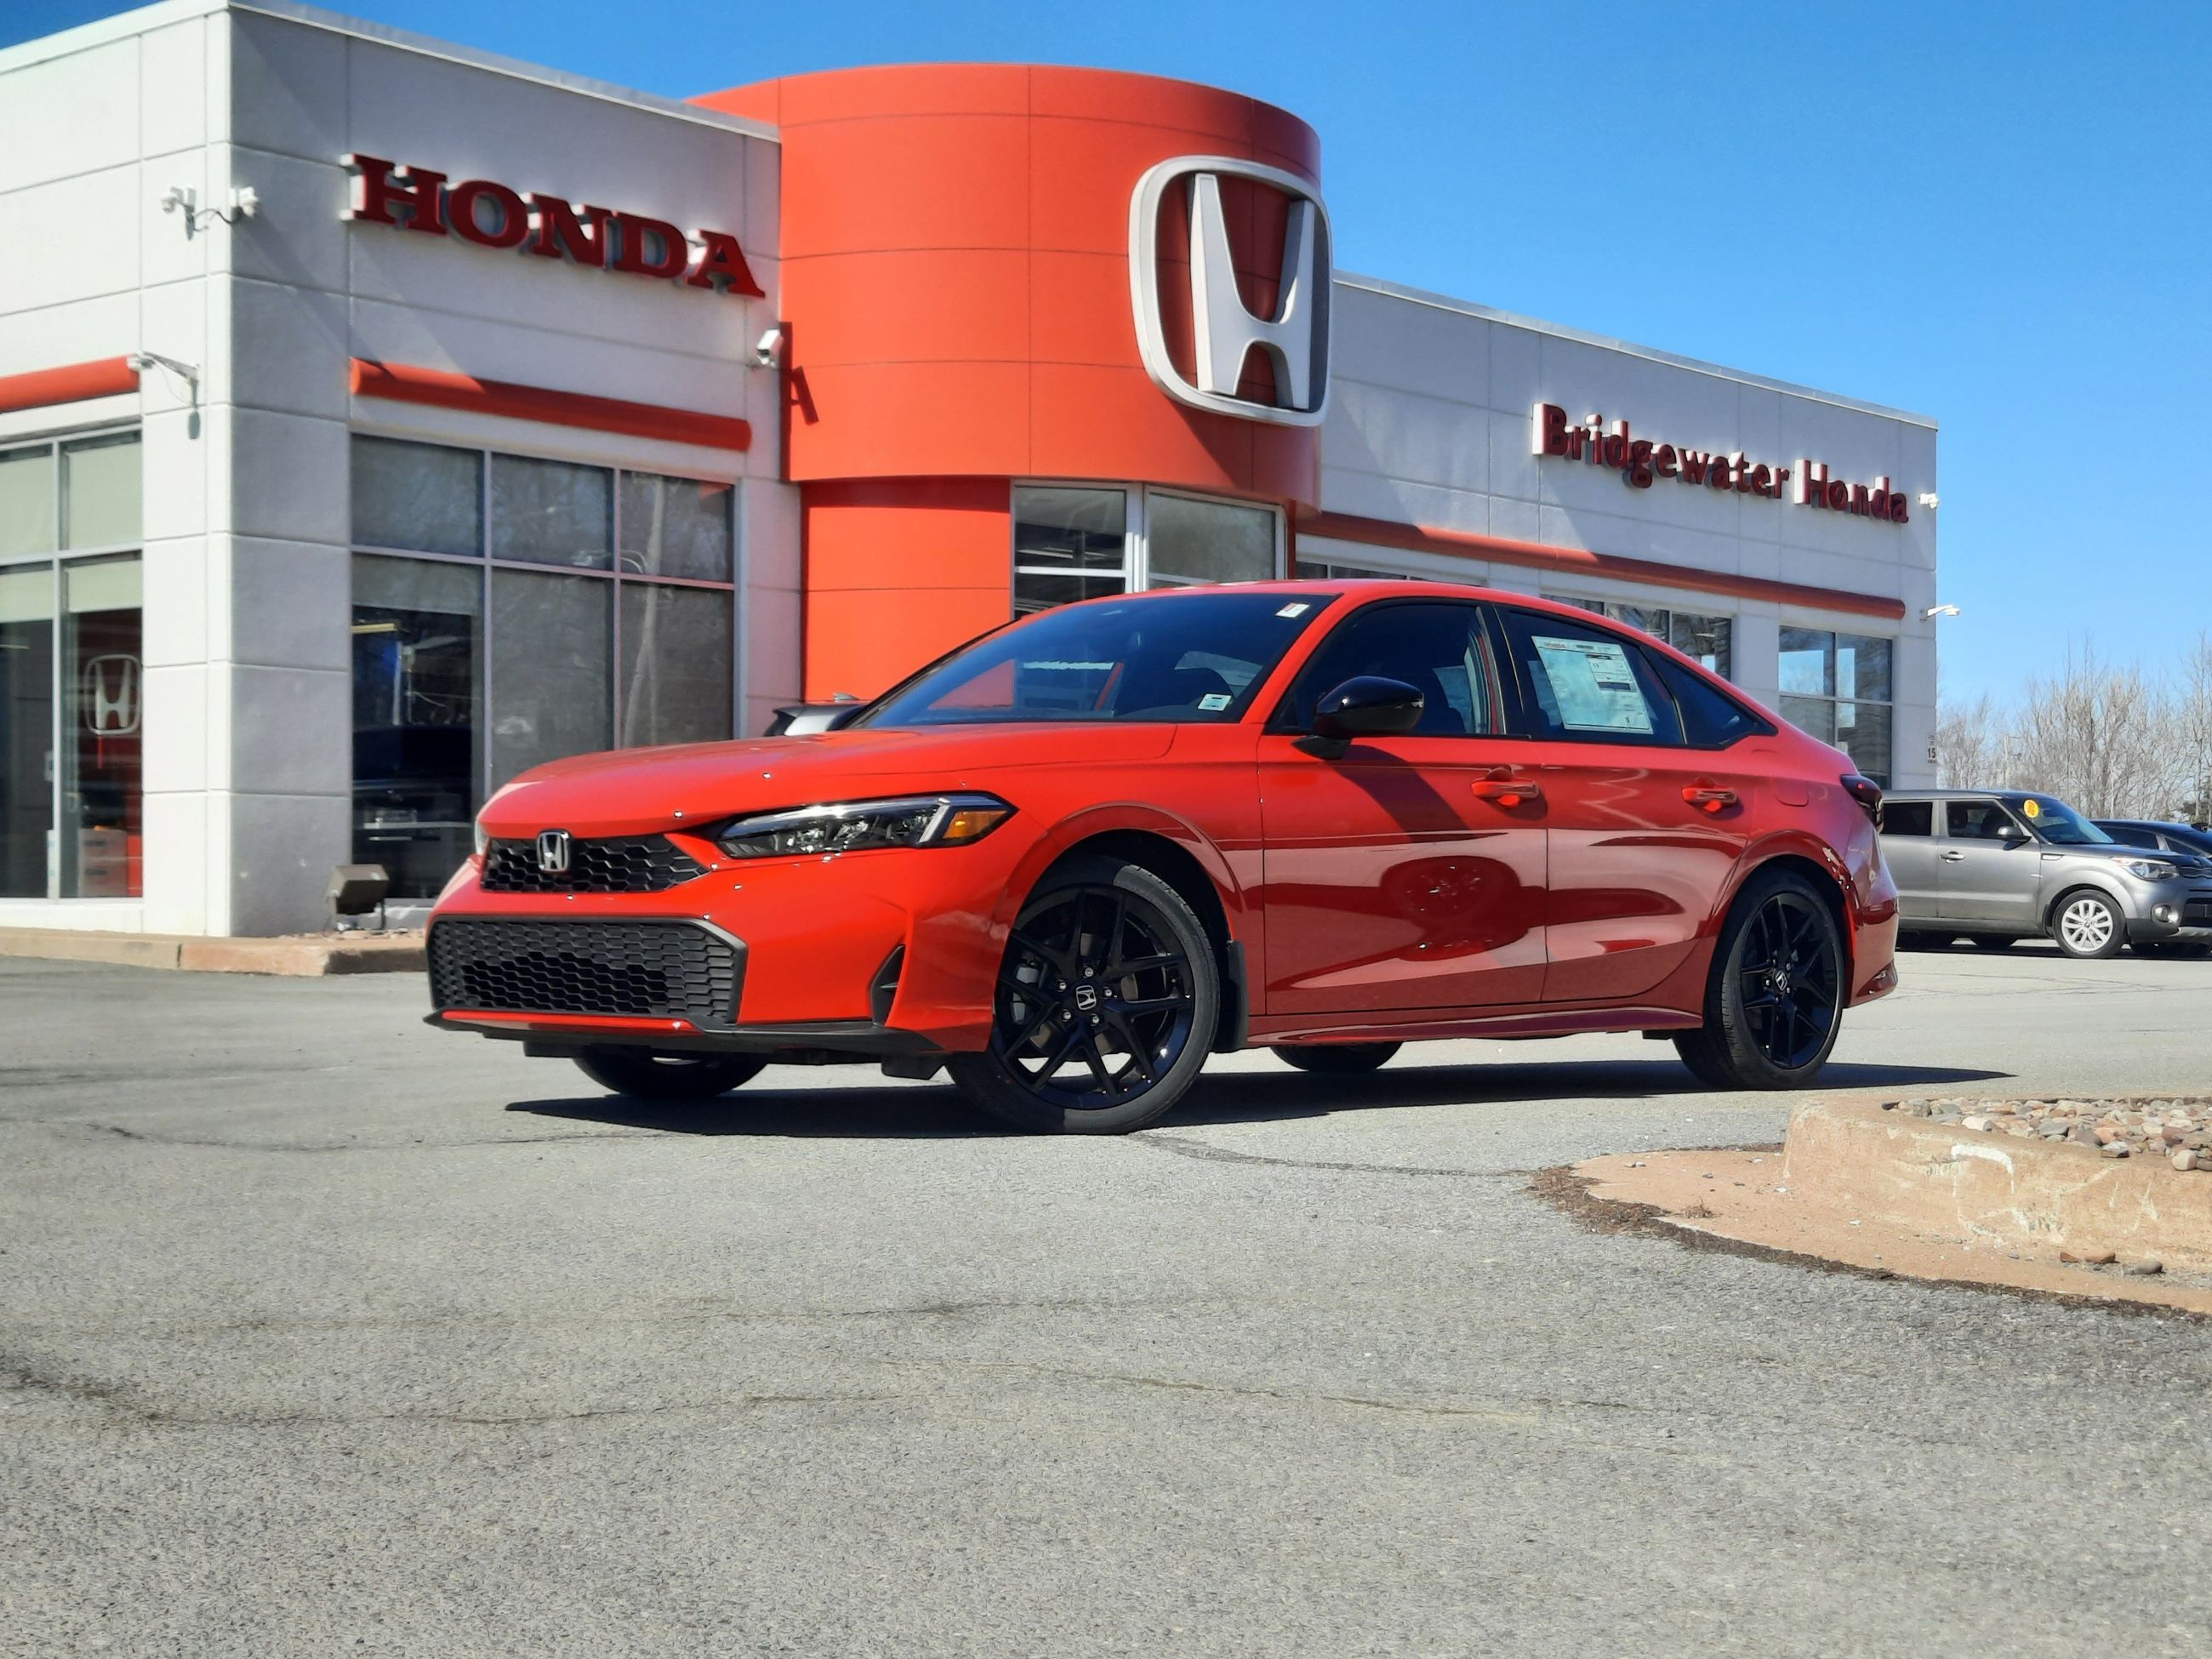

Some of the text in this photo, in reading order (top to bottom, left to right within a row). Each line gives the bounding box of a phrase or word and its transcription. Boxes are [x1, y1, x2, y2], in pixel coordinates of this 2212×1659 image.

[343, 153, 765, 298] HONDA
[1534, 402, 1909, 524] Bridgewater Honda
[1928, 747, 1936, 759] 15
